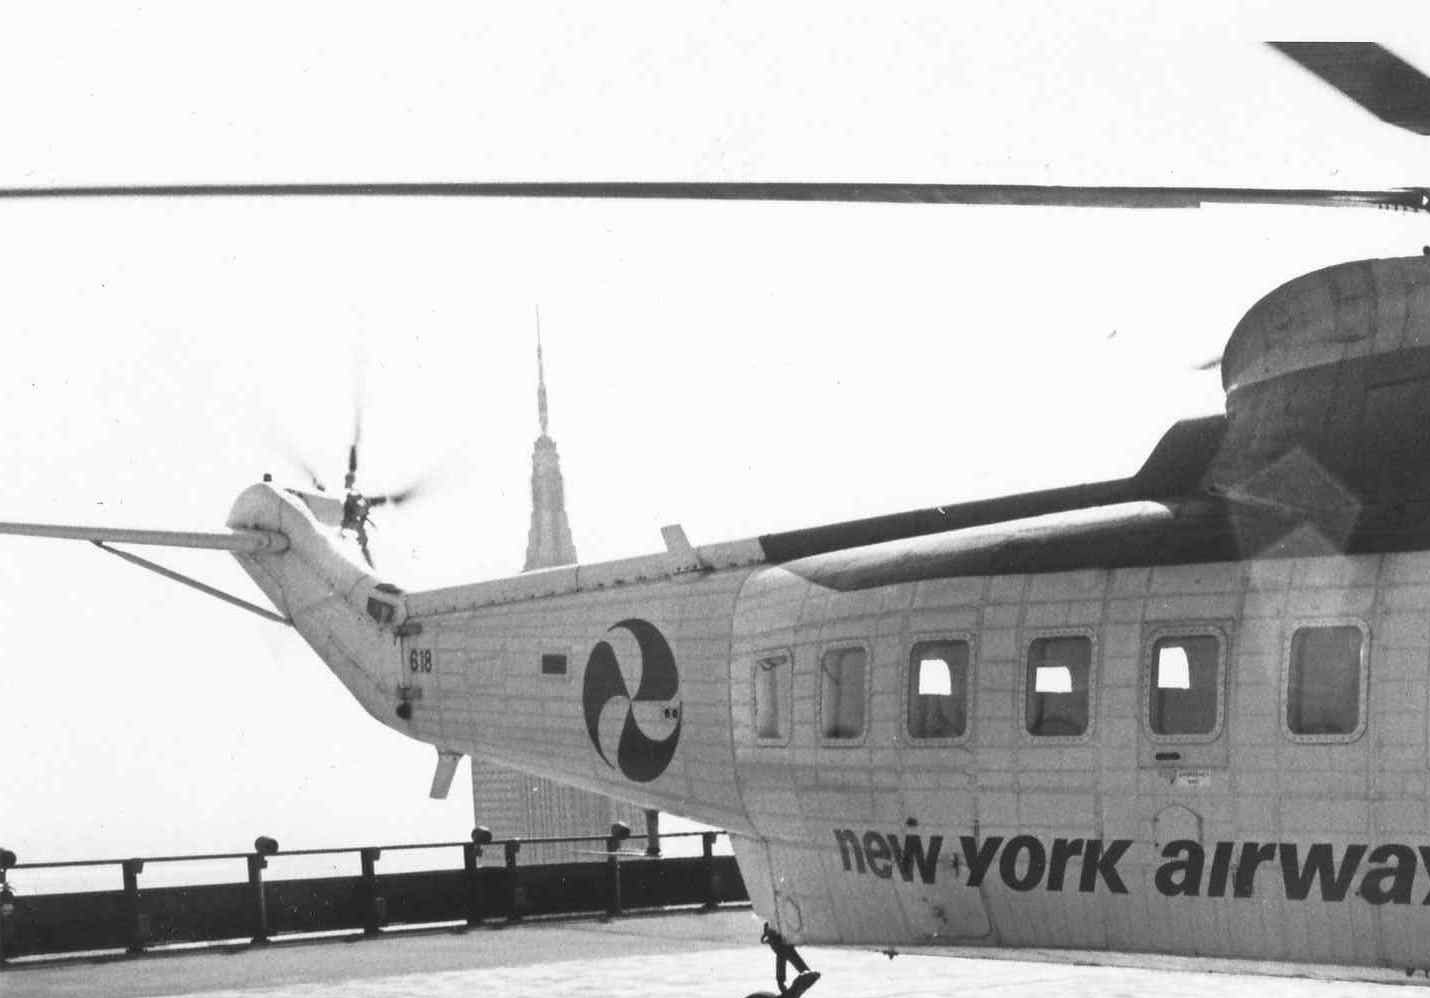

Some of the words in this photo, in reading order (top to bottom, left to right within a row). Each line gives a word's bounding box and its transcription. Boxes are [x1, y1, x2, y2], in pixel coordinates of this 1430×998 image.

[410, 648, 432, 673] 618
[834, 829, 944, 884] new
[959, 835, 1135, 894] york
